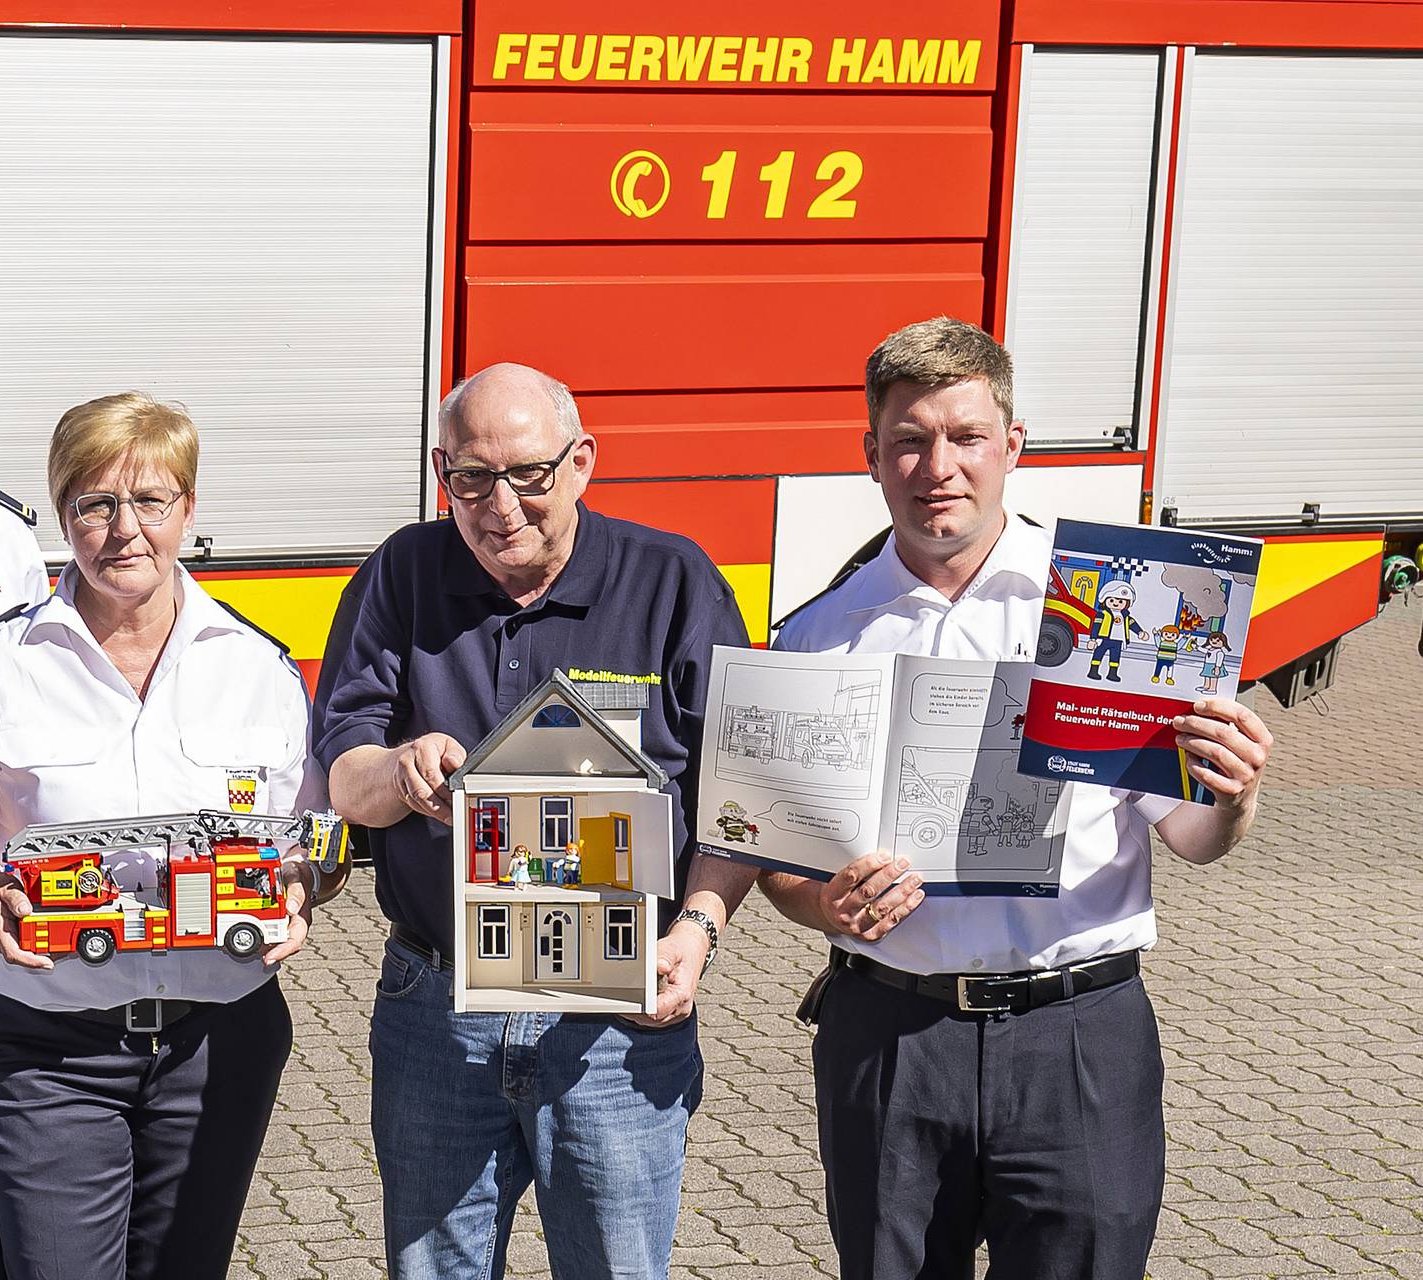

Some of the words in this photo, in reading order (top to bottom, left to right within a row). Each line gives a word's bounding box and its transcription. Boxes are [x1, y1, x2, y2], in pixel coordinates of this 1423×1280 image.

[491, 32, 813, 83] FEUERWEHR
[826, 38, 983, 85] HAMM
[701, 150, 864, 219] 112
[1221, 544, 1253, 556] Hamm:
[568, 668, 662, 685] Modellfeuerwehr
[1054, 712, 1107, 727] Feuerwehr
[1108, 719, 1140, 732] Hamm
[1056, 701, 1078, 711] Mal-
[1080, 705, 1099, 715] und
[1100, 707, 1155, 723] Rätselbuch
[1156, 713, 1174, 725] der
